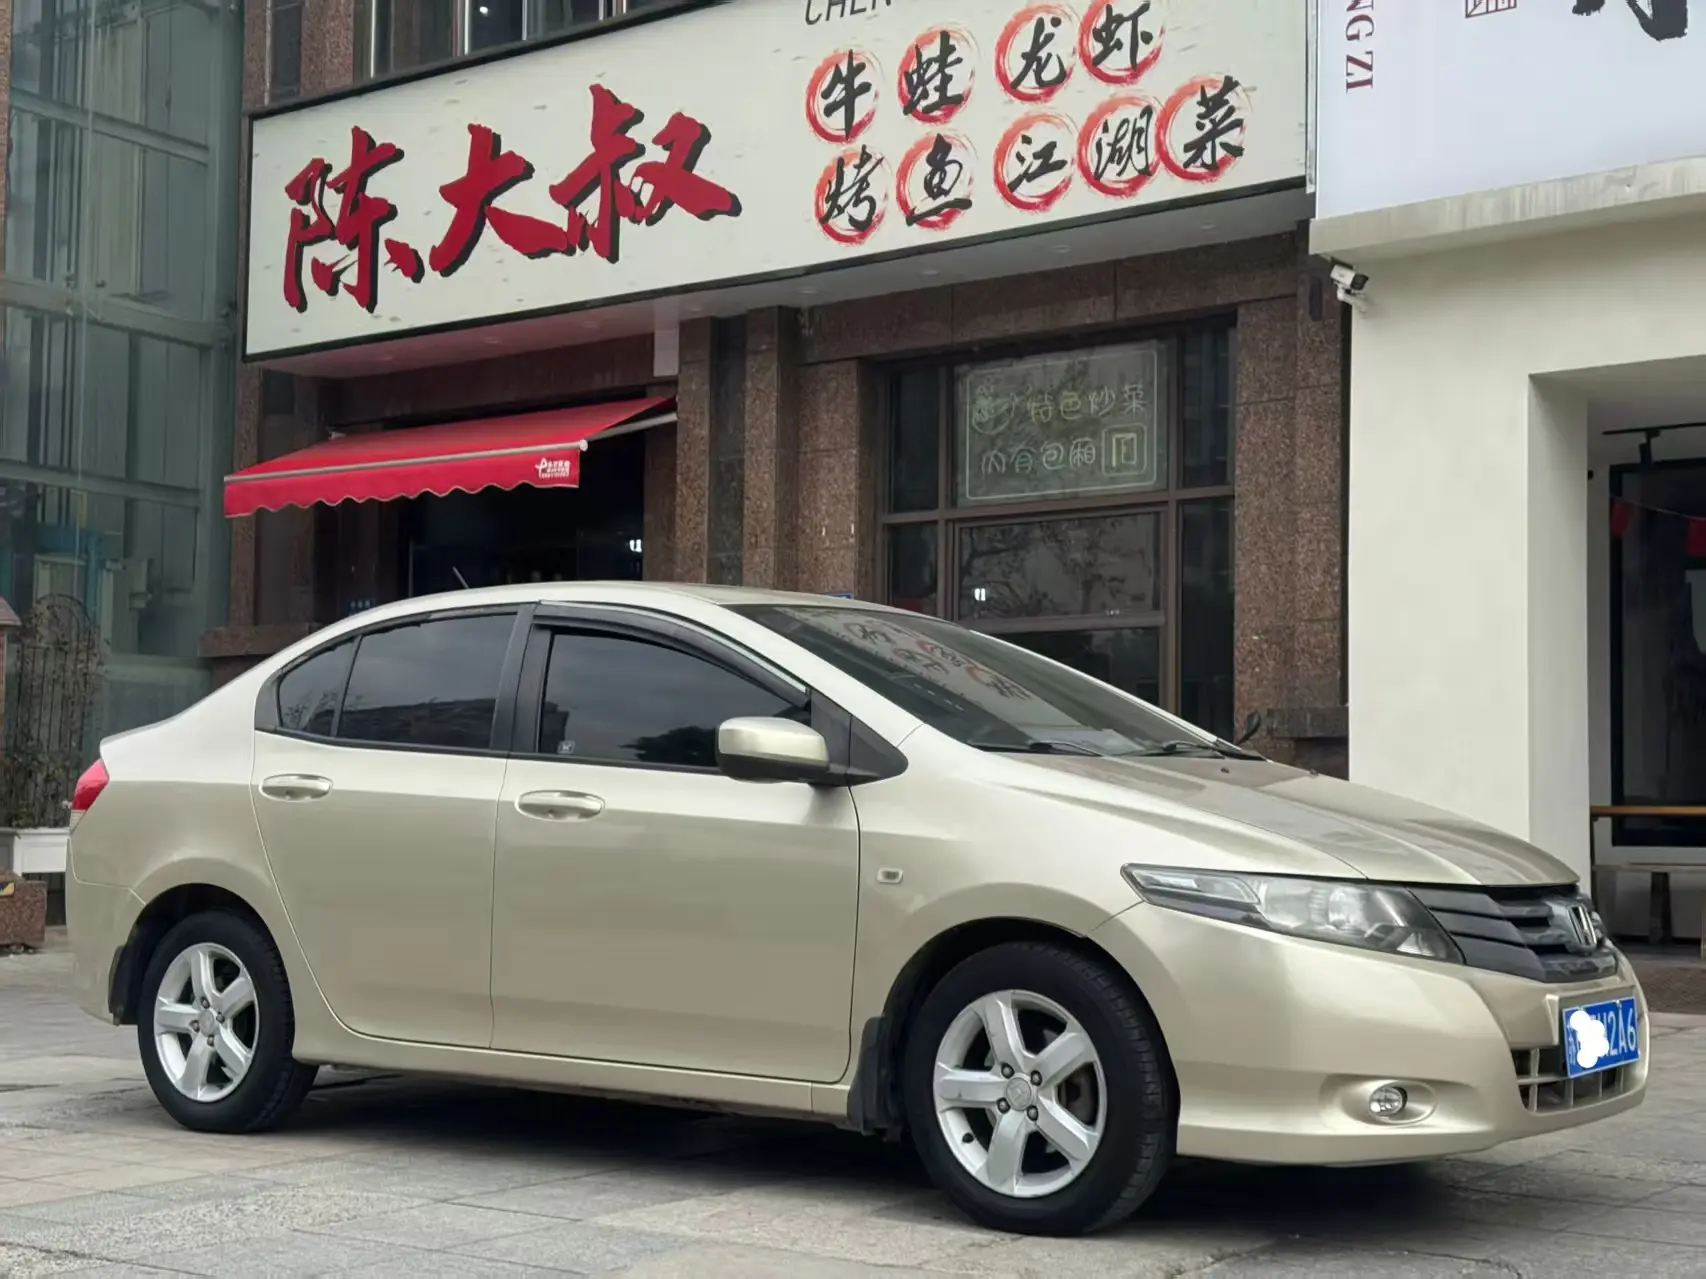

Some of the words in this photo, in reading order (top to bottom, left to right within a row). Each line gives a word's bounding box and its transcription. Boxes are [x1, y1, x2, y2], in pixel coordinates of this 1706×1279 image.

[284, 84, 741, 313] 陈大叔
[1008, 76, 1245, 193] 江湖菜
